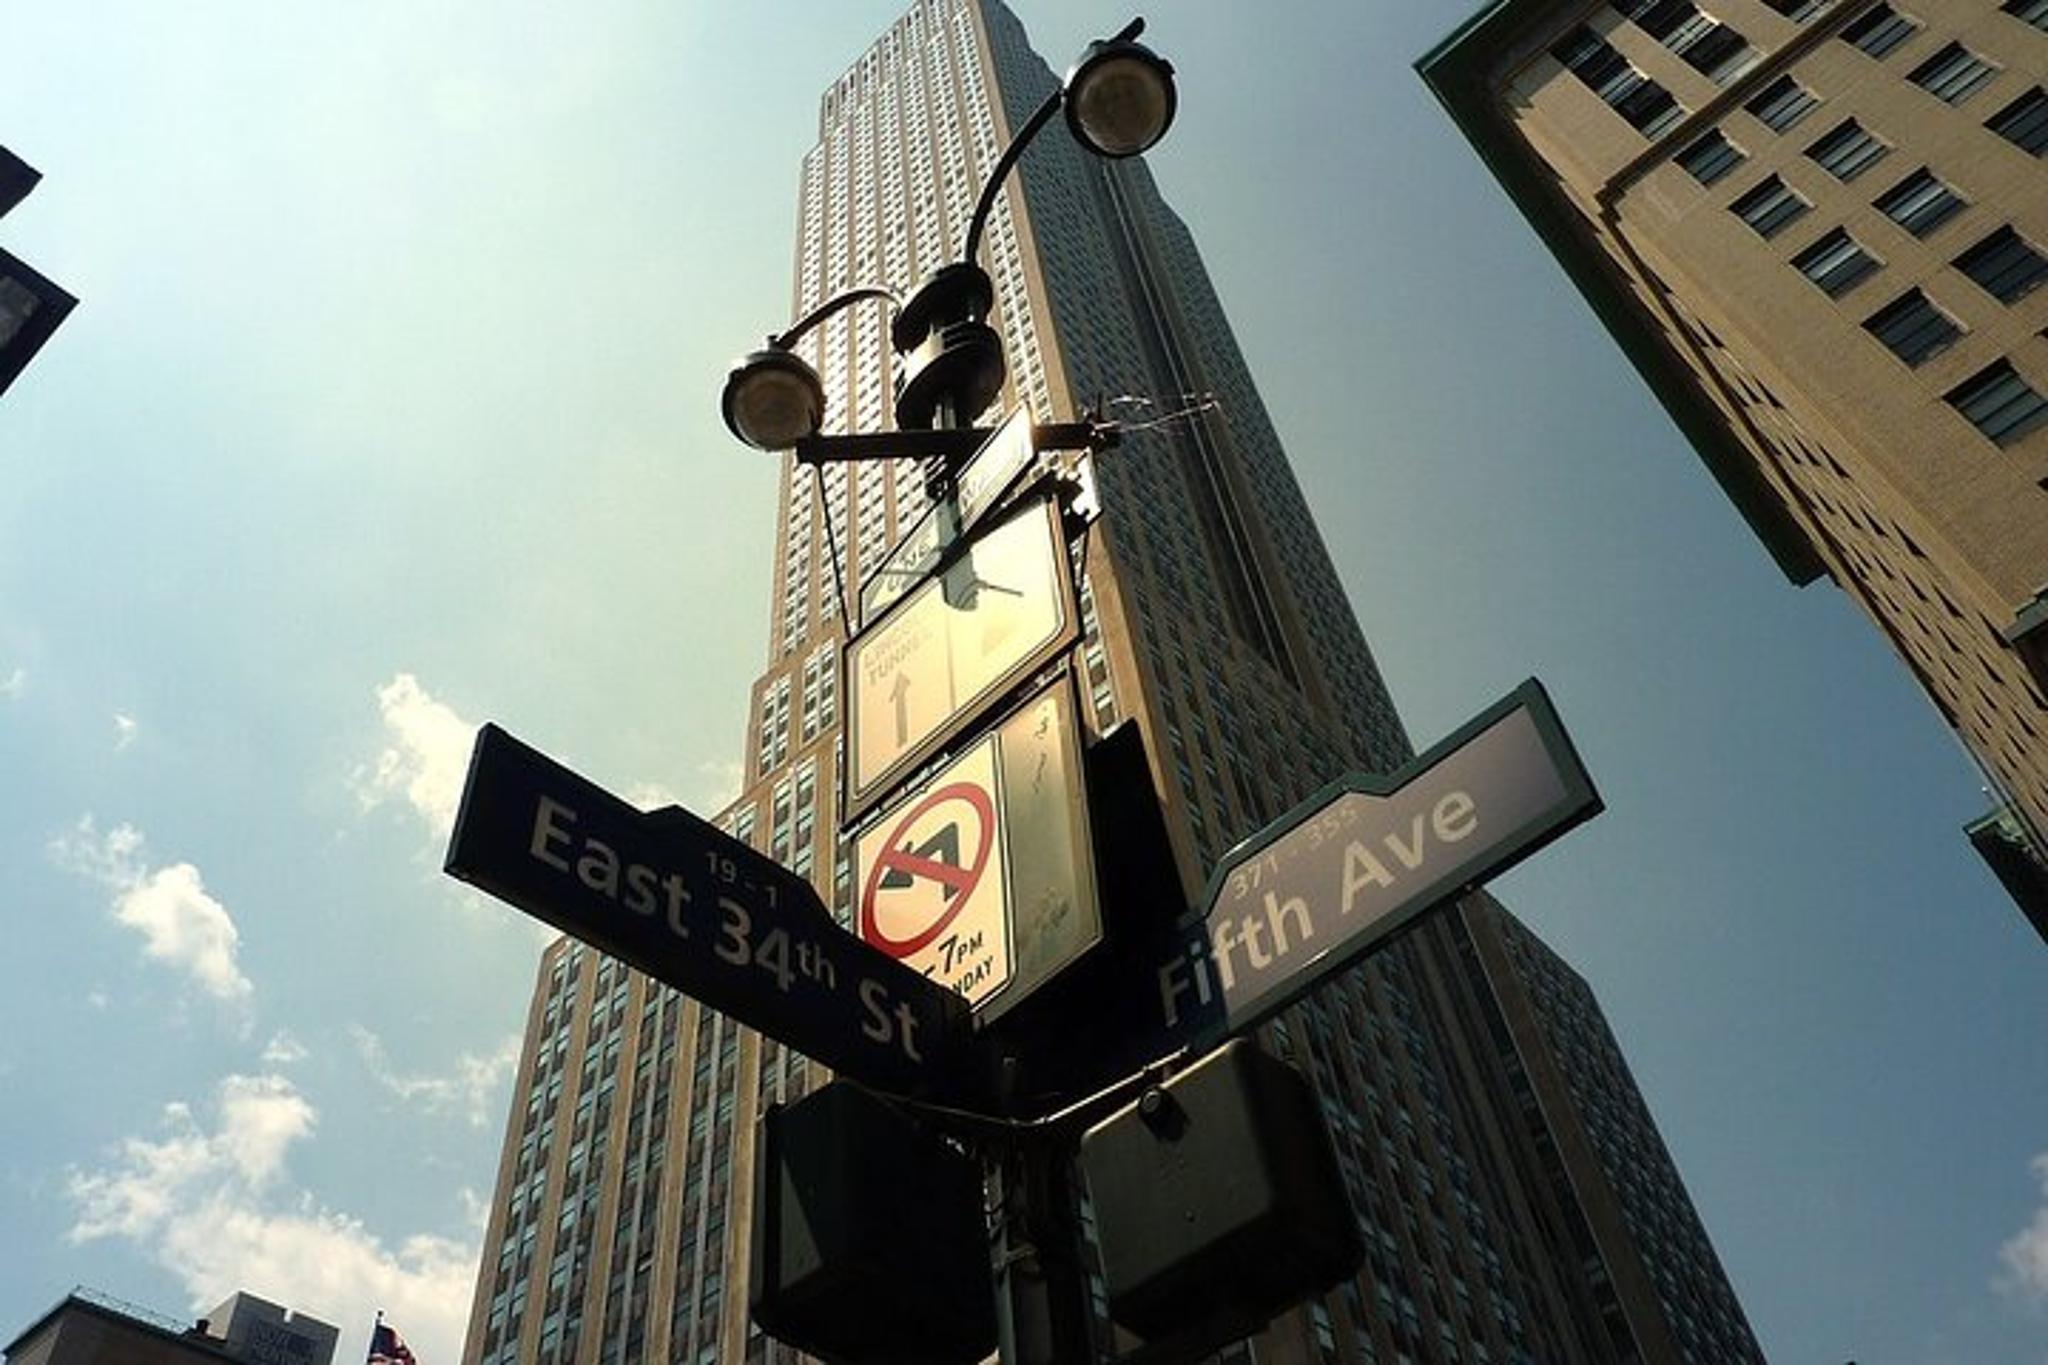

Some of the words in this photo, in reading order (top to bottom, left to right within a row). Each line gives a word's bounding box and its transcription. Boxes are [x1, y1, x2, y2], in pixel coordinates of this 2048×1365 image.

[530, 795, 693, 938] East
[714, 897, 836, 993] 34th
[858, 976, 923, 1064] St
[1159, 890, 1314, 1027] Fifth
[1341, 790, 1479, 915] Ave
